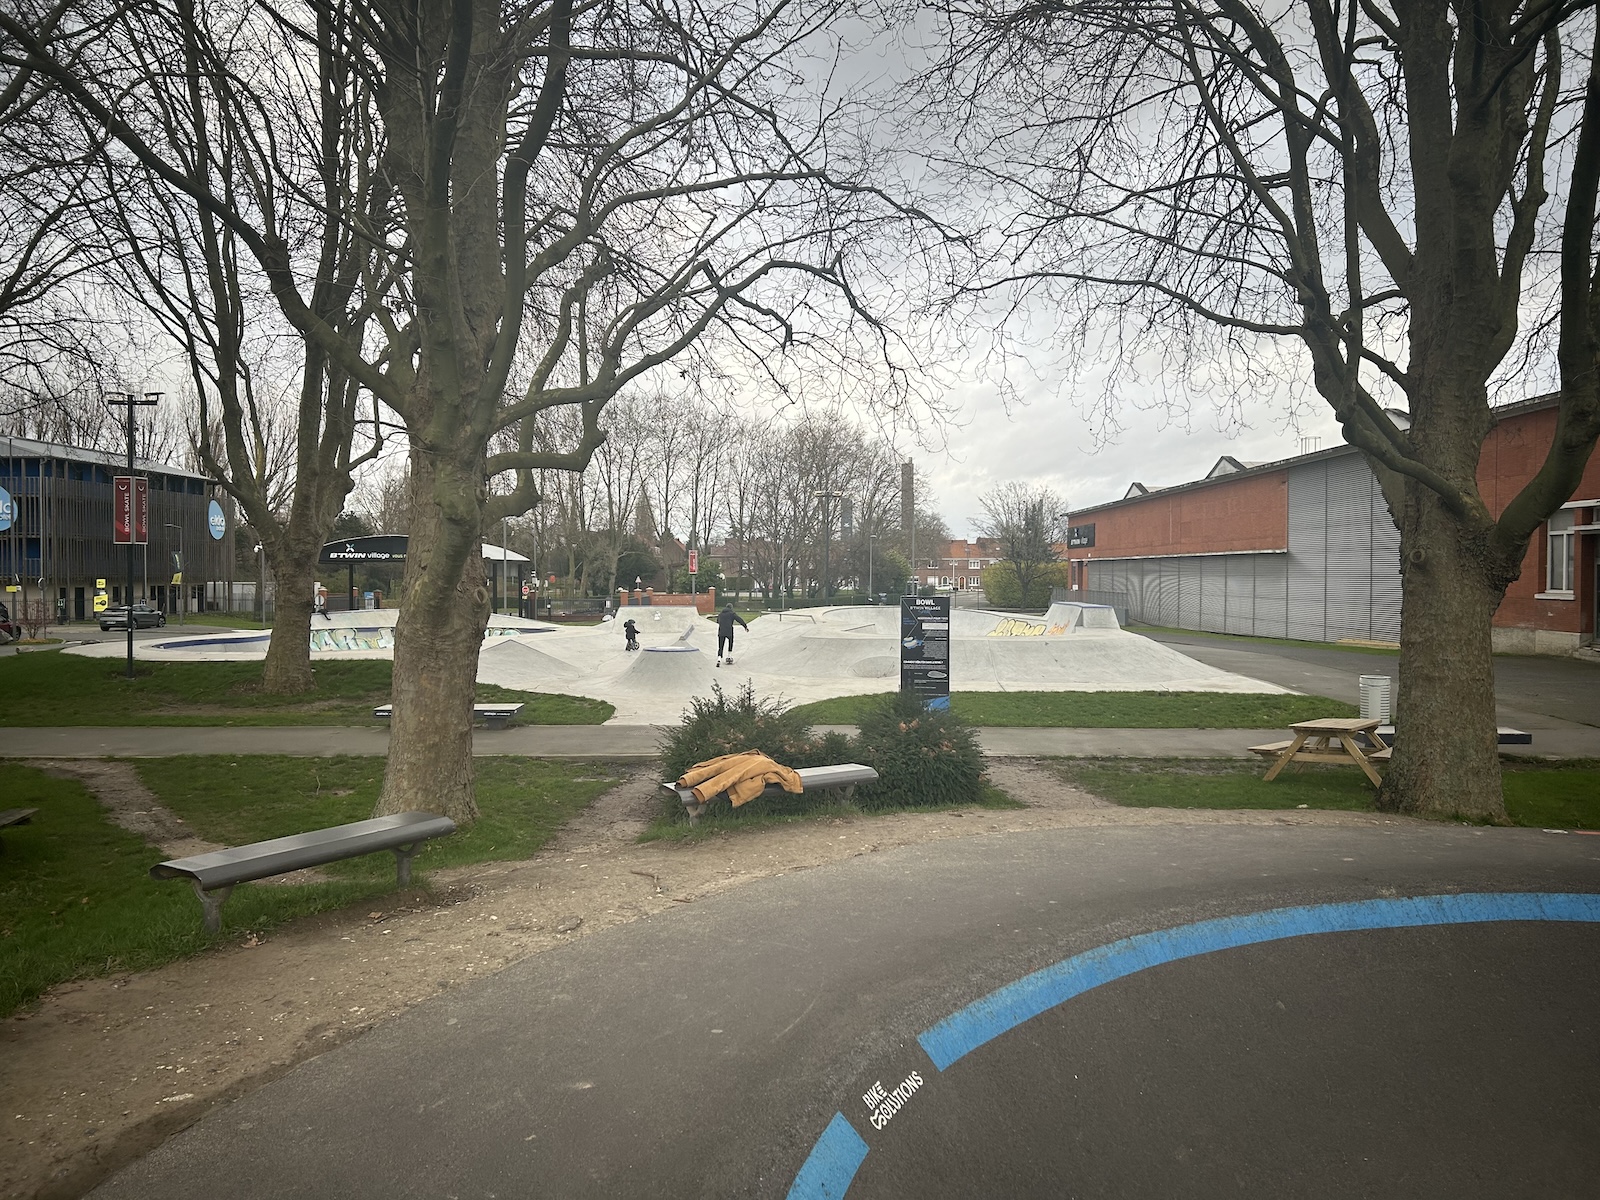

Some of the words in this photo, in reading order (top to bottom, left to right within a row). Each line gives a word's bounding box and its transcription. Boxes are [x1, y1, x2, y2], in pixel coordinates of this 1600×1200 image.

[367, 552, 390, 560] village
[862, 1080, 888, 1111] BIKE
[869, 1070, 924, 1130] SOLUTIONS
